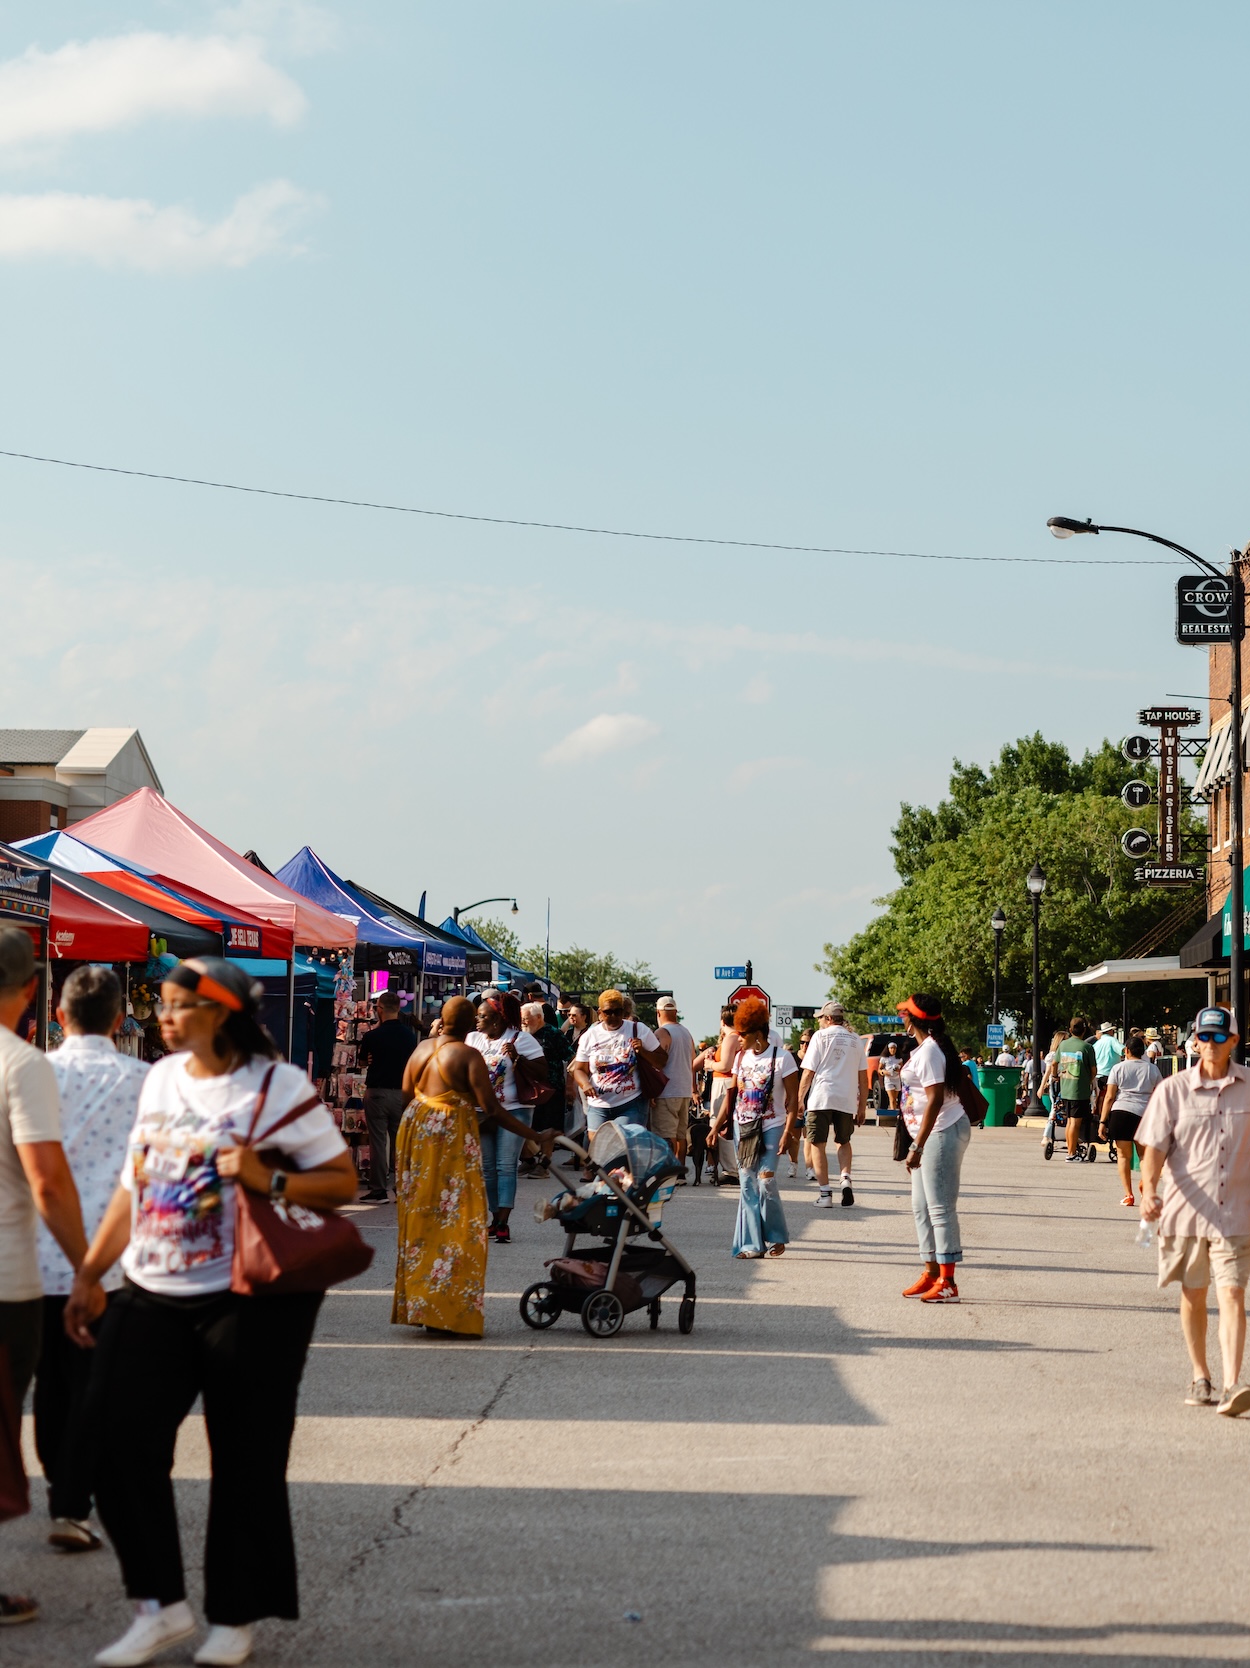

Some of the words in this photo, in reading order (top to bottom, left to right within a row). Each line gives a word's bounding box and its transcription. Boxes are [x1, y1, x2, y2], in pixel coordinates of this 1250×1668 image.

[1184, 591, 1233, 603] CROW
[1181, 624, 1206, 634] REAL
[1207, 624, 1233, 634] ESTA
[1144, 711, 1163, 721] TAP
[1164, 711, 1196, 721] HOUSE
[1164, 727, 1176, 794] TWISTED
[1165, 797, 1174, 862] SISTERS
[1144, 868, 1195, 879] PIZZERIA
[721, 968, 731, 977] Ave
[777, 1016, 792, 1025] 30
